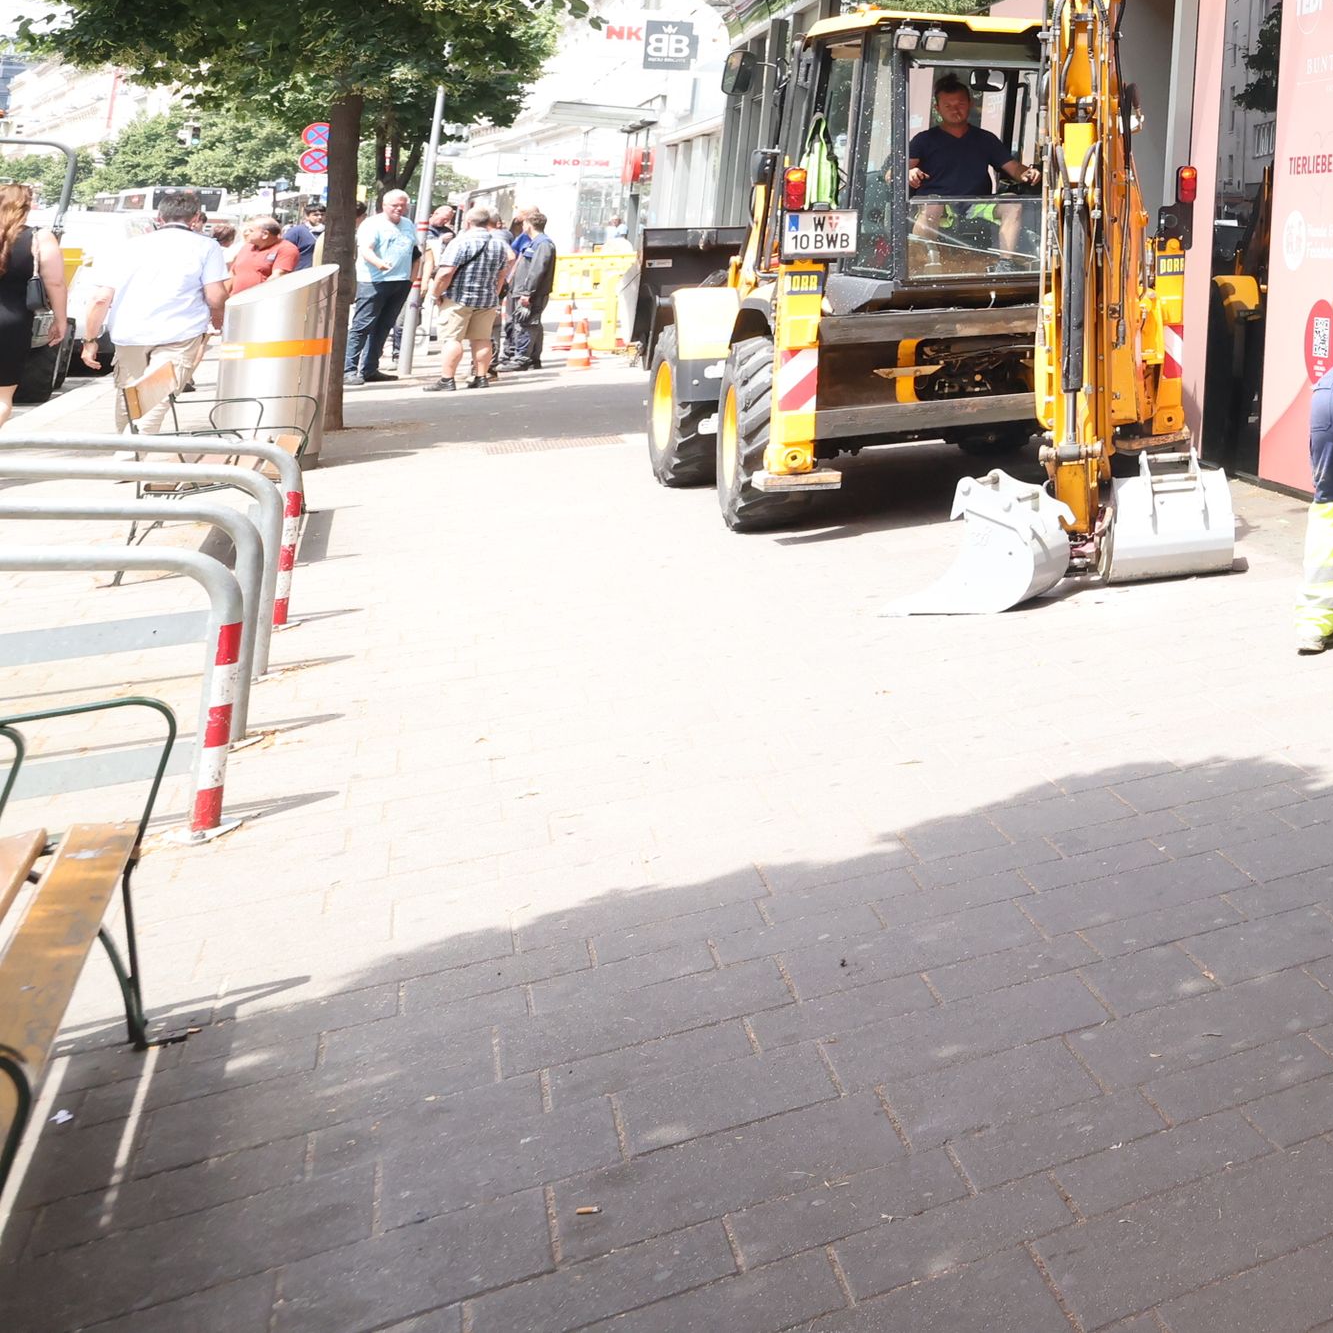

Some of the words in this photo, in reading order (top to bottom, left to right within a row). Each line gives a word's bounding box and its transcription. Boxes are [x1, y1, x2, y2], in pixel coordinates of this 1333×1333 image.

[606, 25, 643, 41] NK
[1288, 153, 1333, 176] TIERLIEBE
[813, 215, 826, 232] W
[791, 233, 810, 250] 10
[814, 233, 850, 249] BWB
